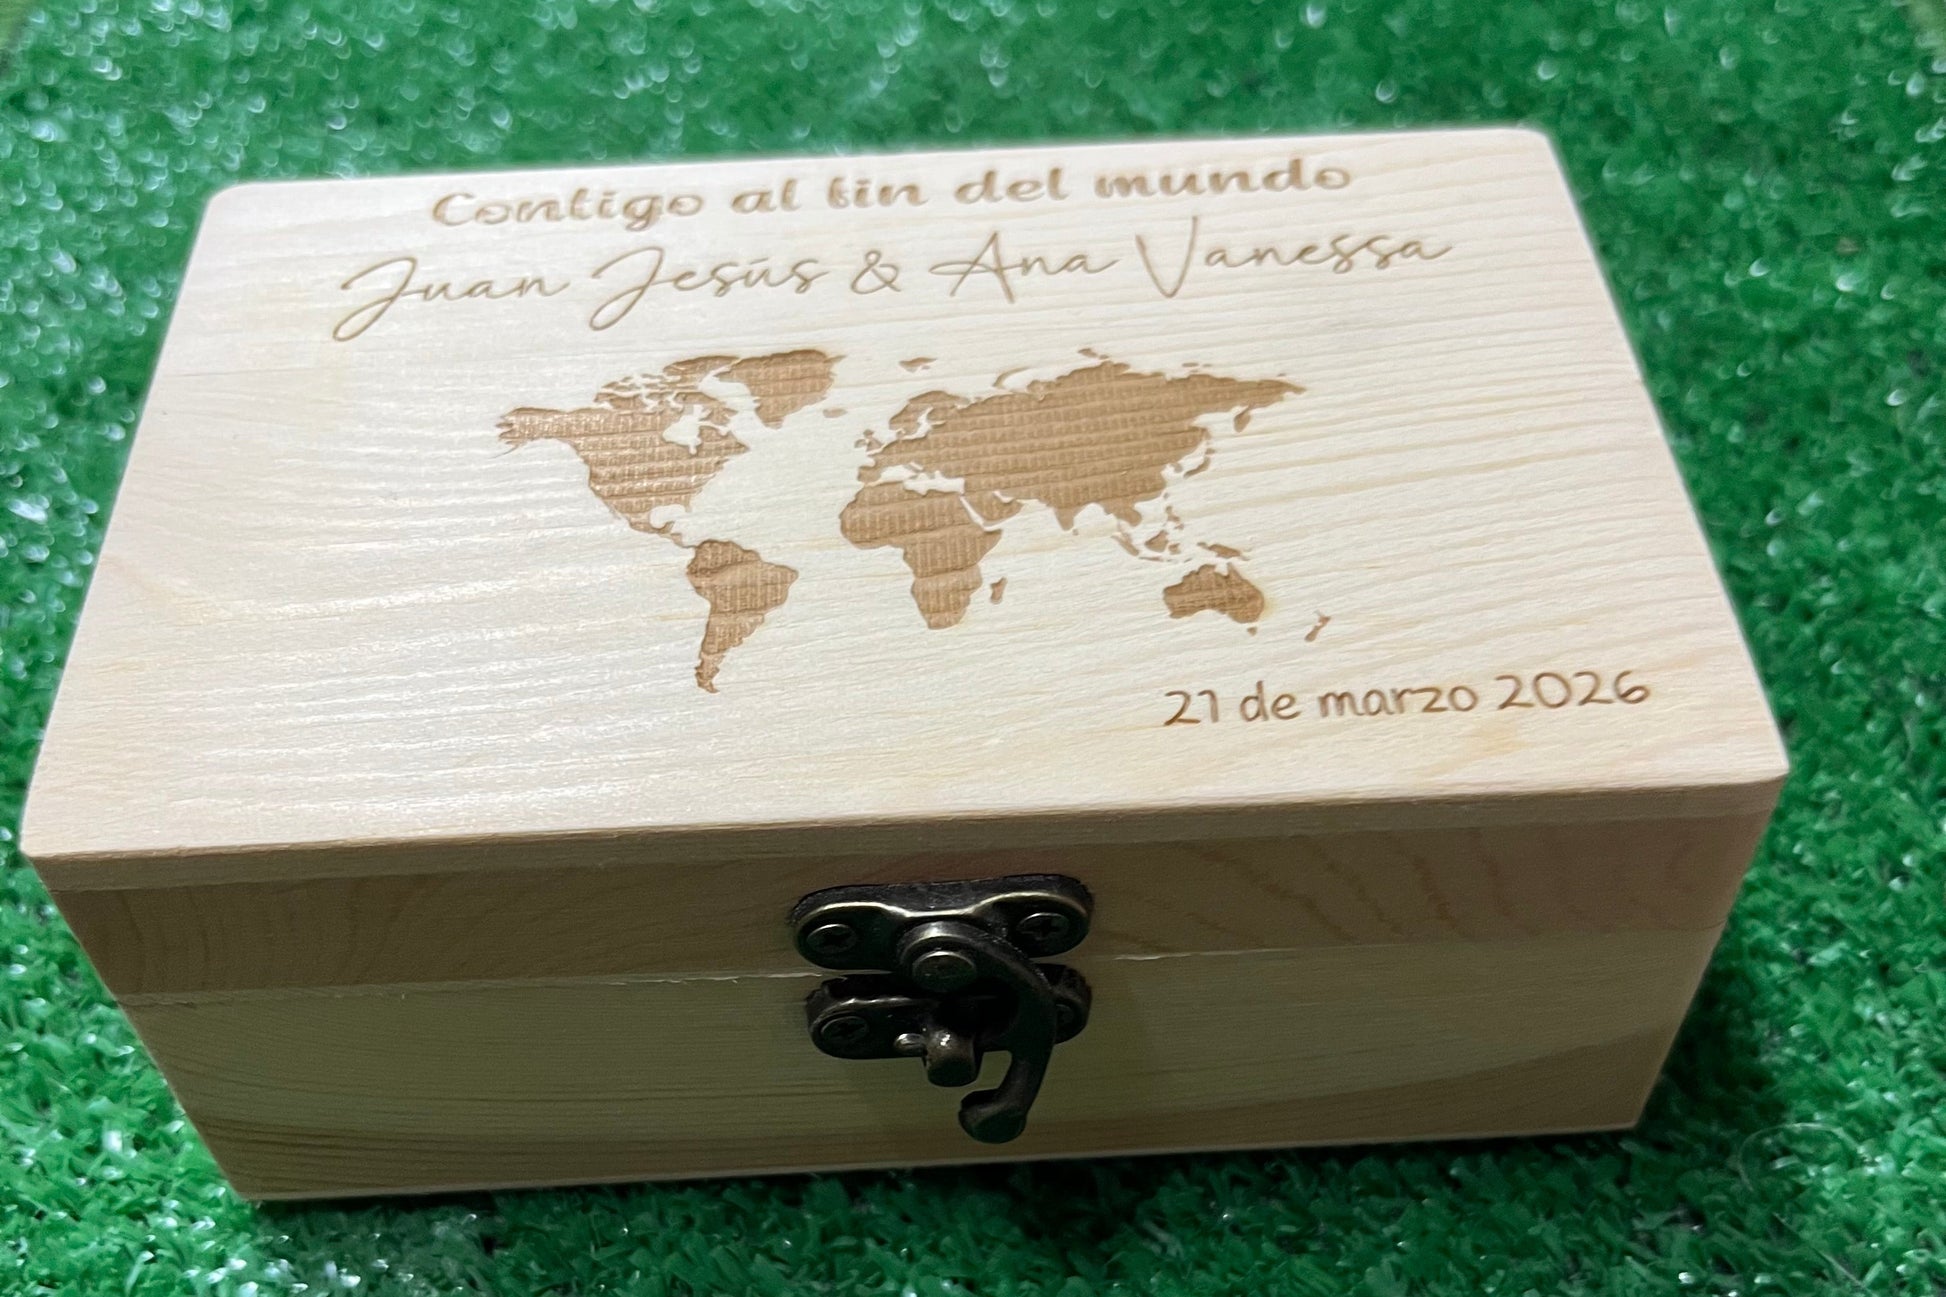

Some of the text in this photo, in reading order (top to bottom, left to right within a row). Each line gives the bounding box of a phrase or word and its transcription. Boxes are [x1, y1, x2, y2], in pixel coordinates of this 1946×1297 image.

[432, 187, 704, 231] Contigo
[732, 178, 800, 215] al
[953, 167, 1070, 205] del
[1093, 157, 1351, 198] mundo
[332, 215, 1453, 342] Juan Jesús & Ana Vanessa
[1163, 669, 1652, 726] 21 de marzo 2026
